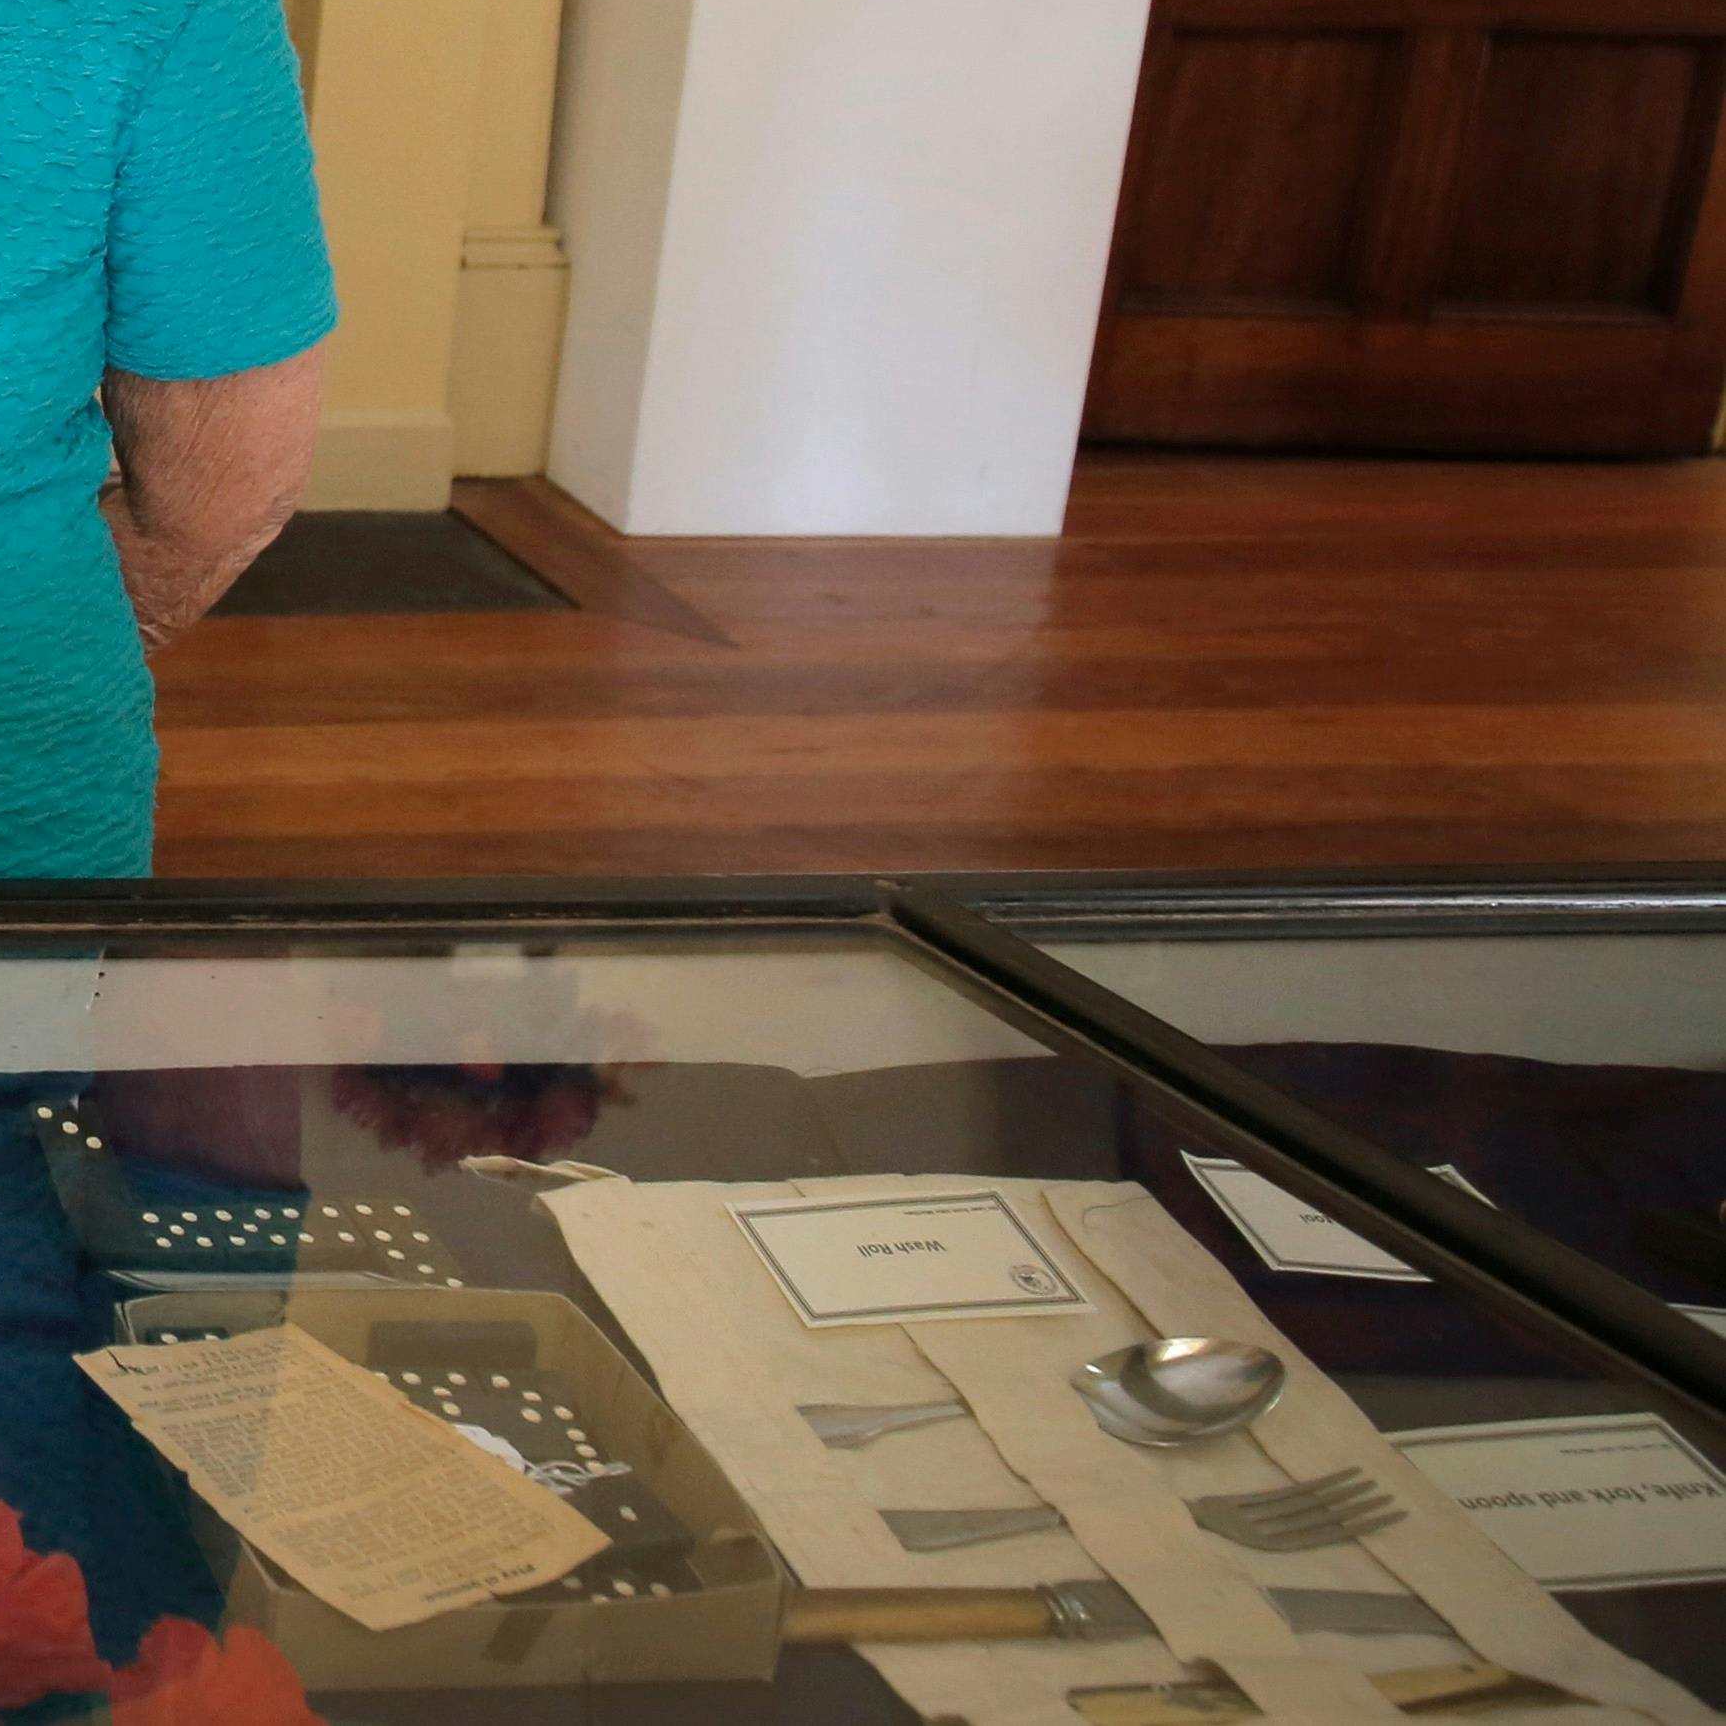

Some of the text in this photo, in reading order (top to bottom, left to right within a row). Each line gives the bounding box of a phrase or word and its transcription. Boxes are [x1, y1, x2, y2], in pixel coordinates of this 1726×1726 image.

[856, 1240, 947, 1258] Wash Roll
[1458, 1481, 1721, 1510] Knife, fork and spoon
